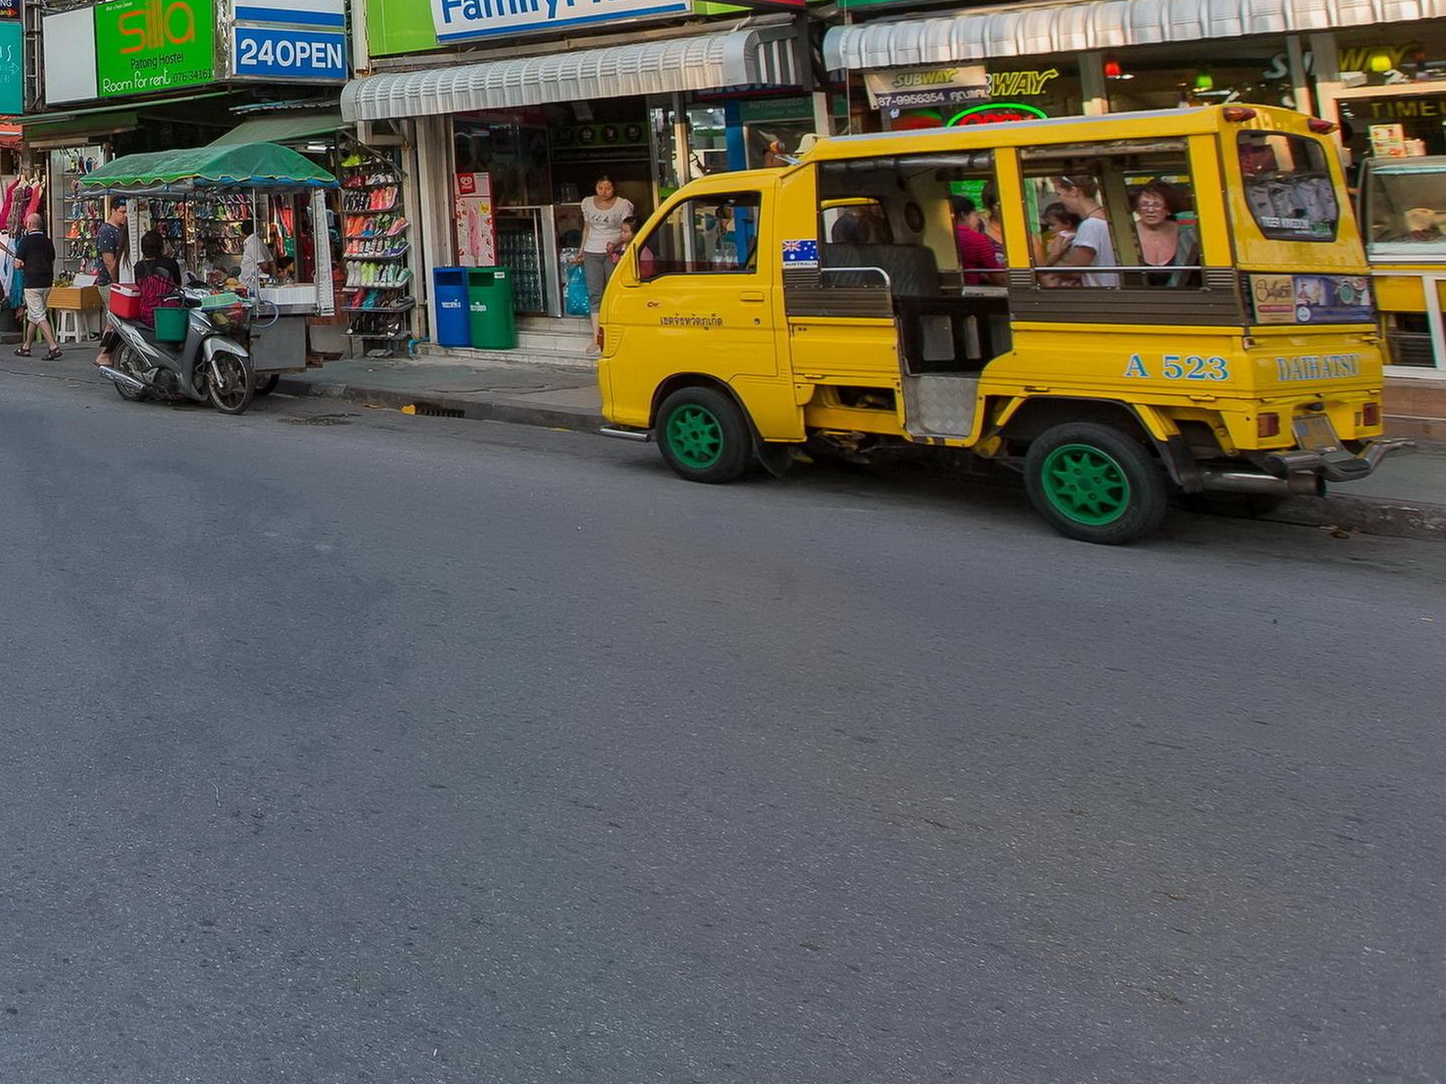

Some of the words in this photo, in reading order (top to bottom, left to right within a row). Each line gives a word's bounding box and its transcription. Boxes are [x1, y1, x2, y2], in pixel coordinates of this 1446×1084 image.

[130, 57, 158, 71] Patong
[159, 52, 185, 67] Hostel
[102, 77, 134, 94] Room
[133, 70, 148, 89] for
[148, 67, 171, 85] rent
[893, 69, 958, 88] SUBWAY
[1124, 354, 1151, 379] A
[1162, 354, 1231, 382] 523
[1275, 354, 1361, 382] DAIHATSU
